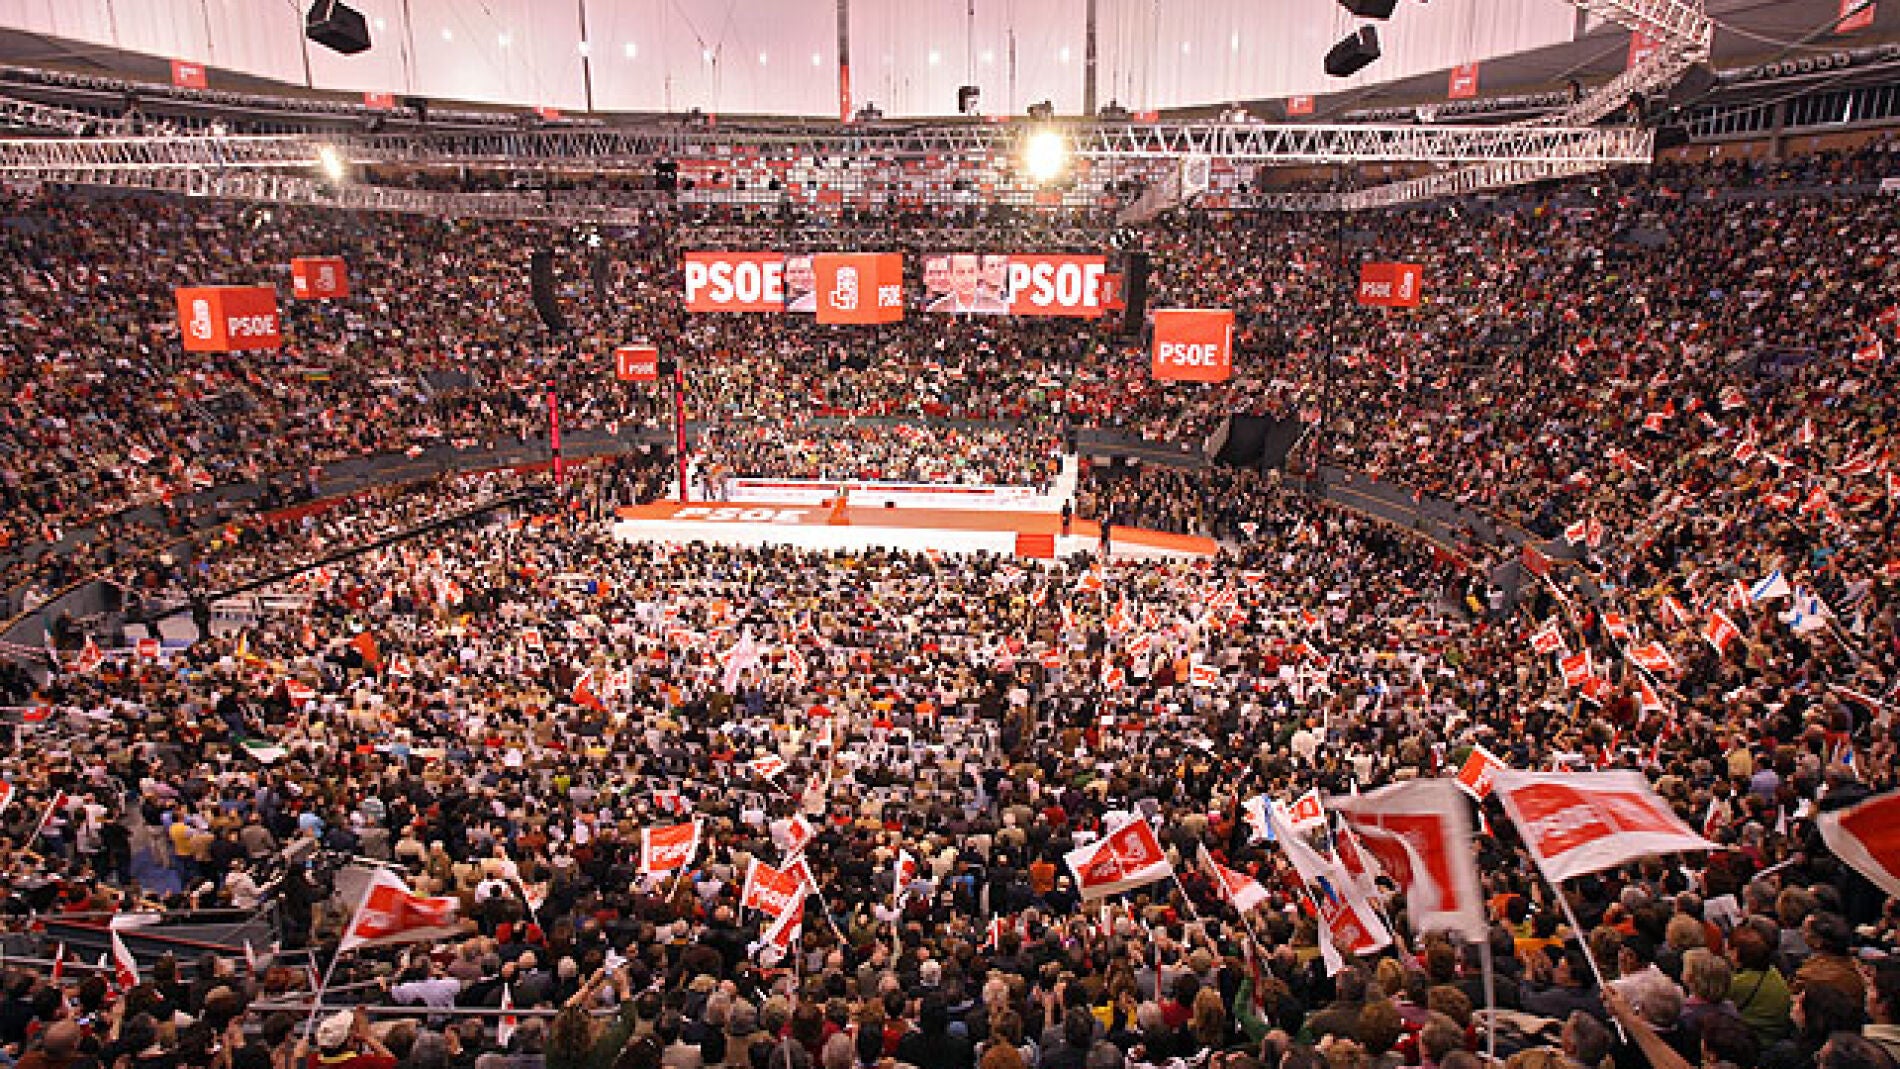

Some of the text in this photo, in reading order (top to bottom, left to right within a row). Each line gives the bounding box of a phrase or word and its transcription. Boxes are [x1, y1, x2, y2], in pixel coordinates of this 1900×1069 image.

[686, 261, 784, 303] PSOE
[228, 315, 277, 337] PSOE
[1160, 342, 1218, 366] PSOE
